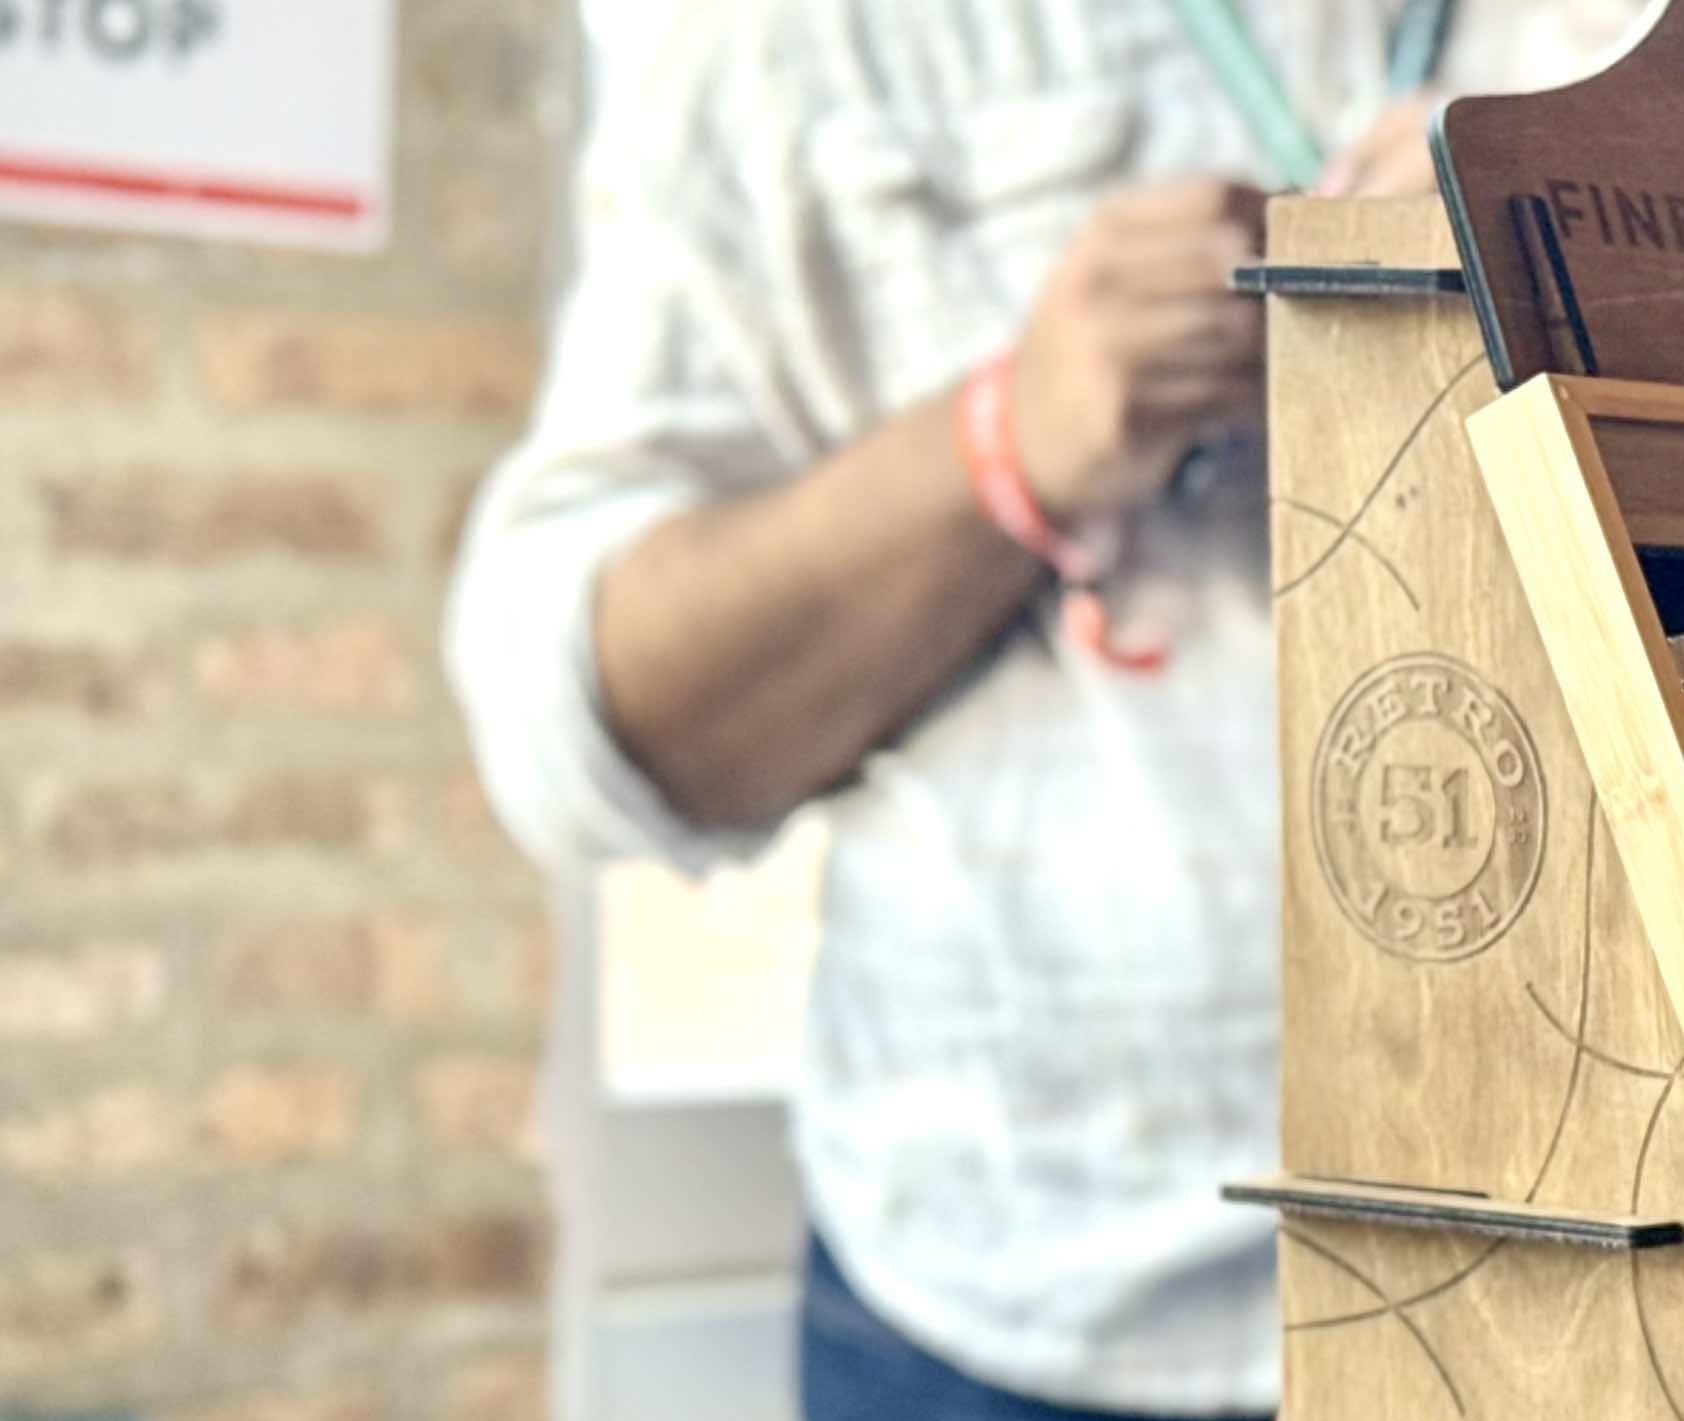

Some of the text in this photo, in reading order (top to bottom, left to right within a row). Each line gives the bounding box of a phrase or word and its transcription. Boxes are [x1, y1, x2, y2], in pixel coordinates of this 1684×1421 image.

[1330, 671, 1525, 787] RETRO
[1380, 763, 1479, 850] 51
[1354, 884, 1501, 949] 1951
